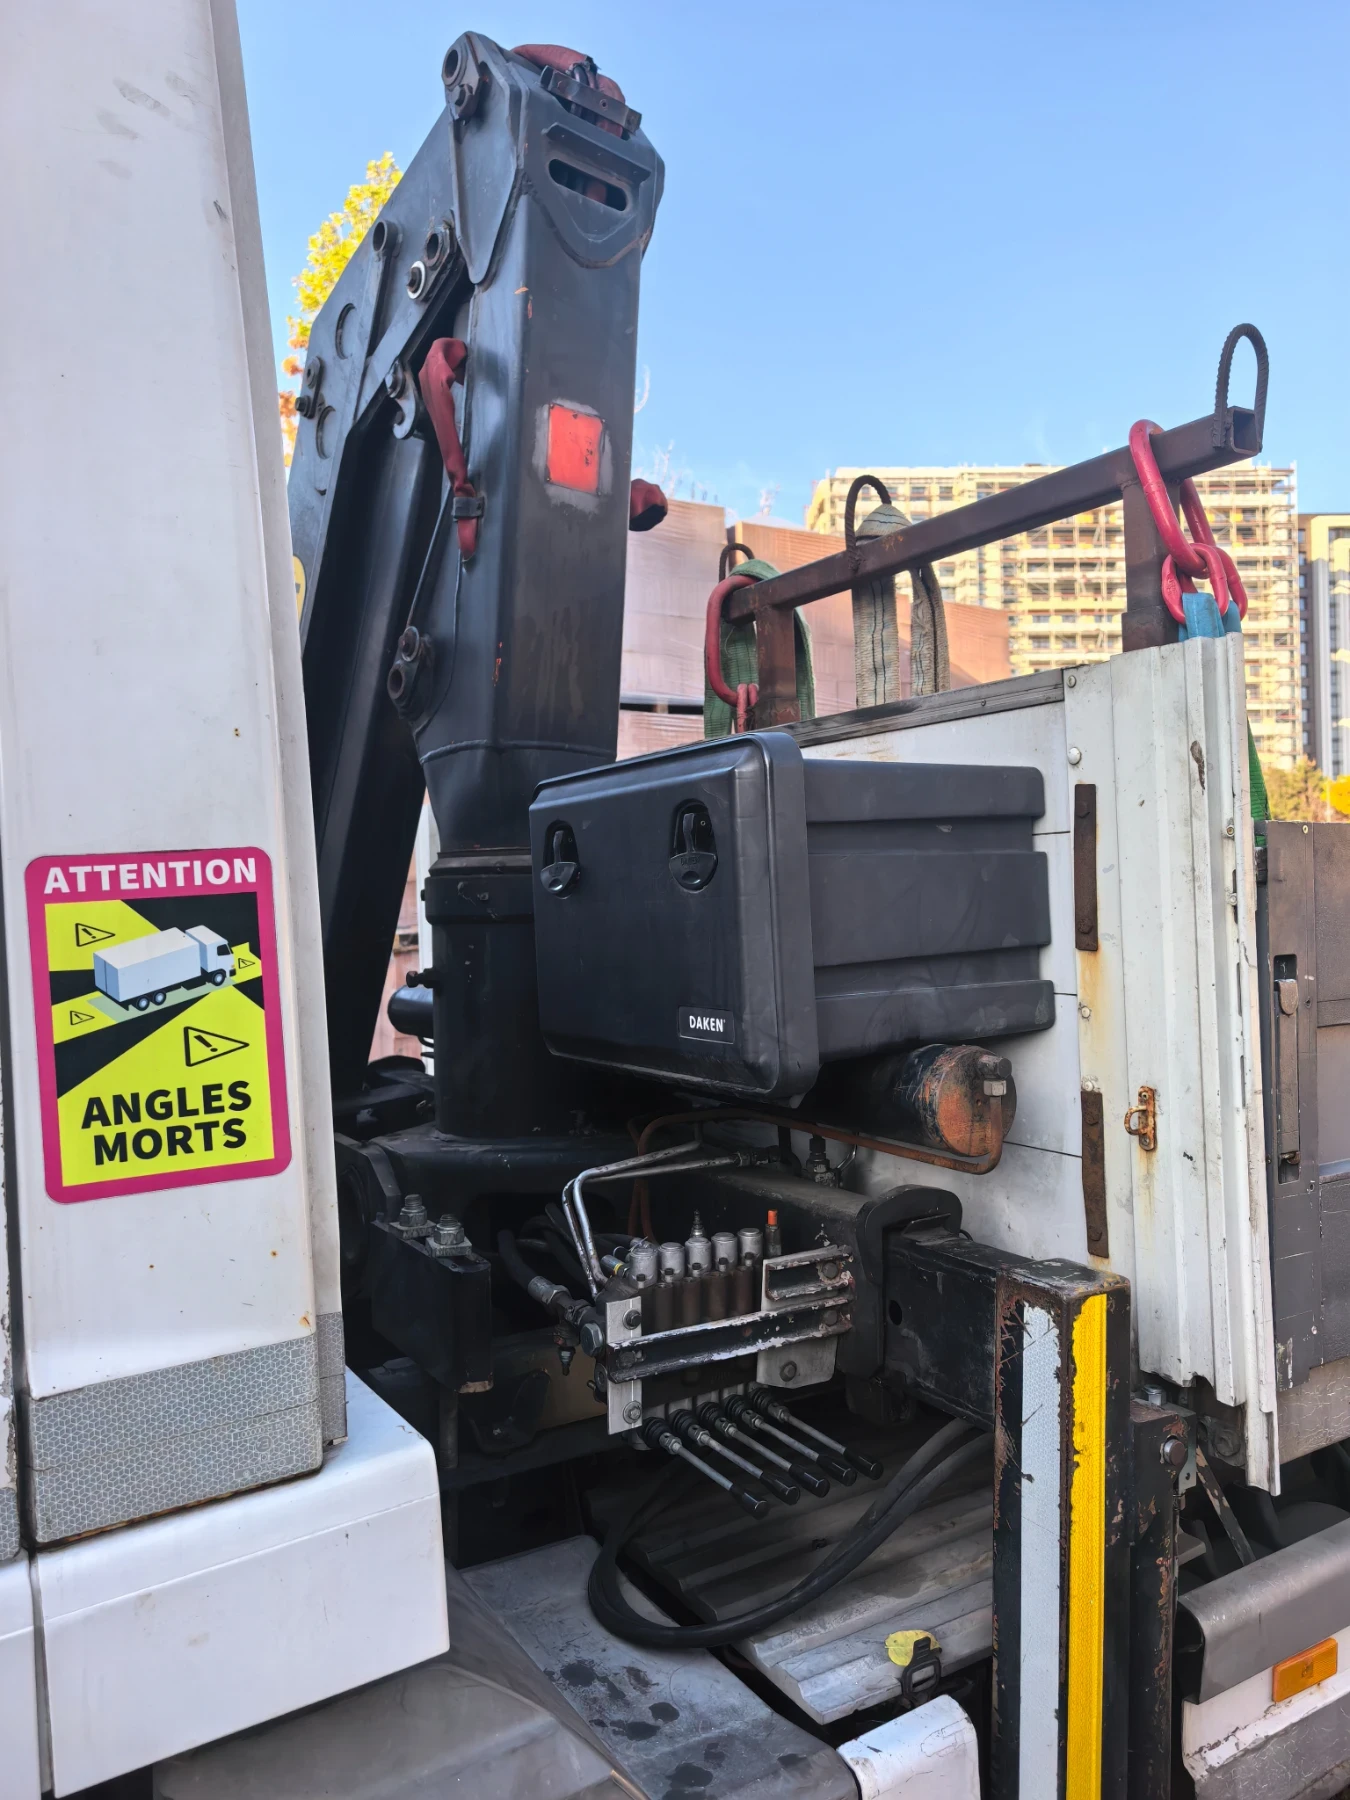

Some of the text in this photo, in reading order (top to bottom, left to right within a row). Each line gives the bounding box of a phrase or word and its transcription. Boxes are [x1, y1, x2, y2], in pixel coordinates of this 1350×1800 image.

[44, 858, 257, 894] ATTENTION
[689, 1015, 724, 1033] DAKEN
[81, 1080, 252, 1130] ANGLES
[94, 1118, 247, 1166] MORTS
